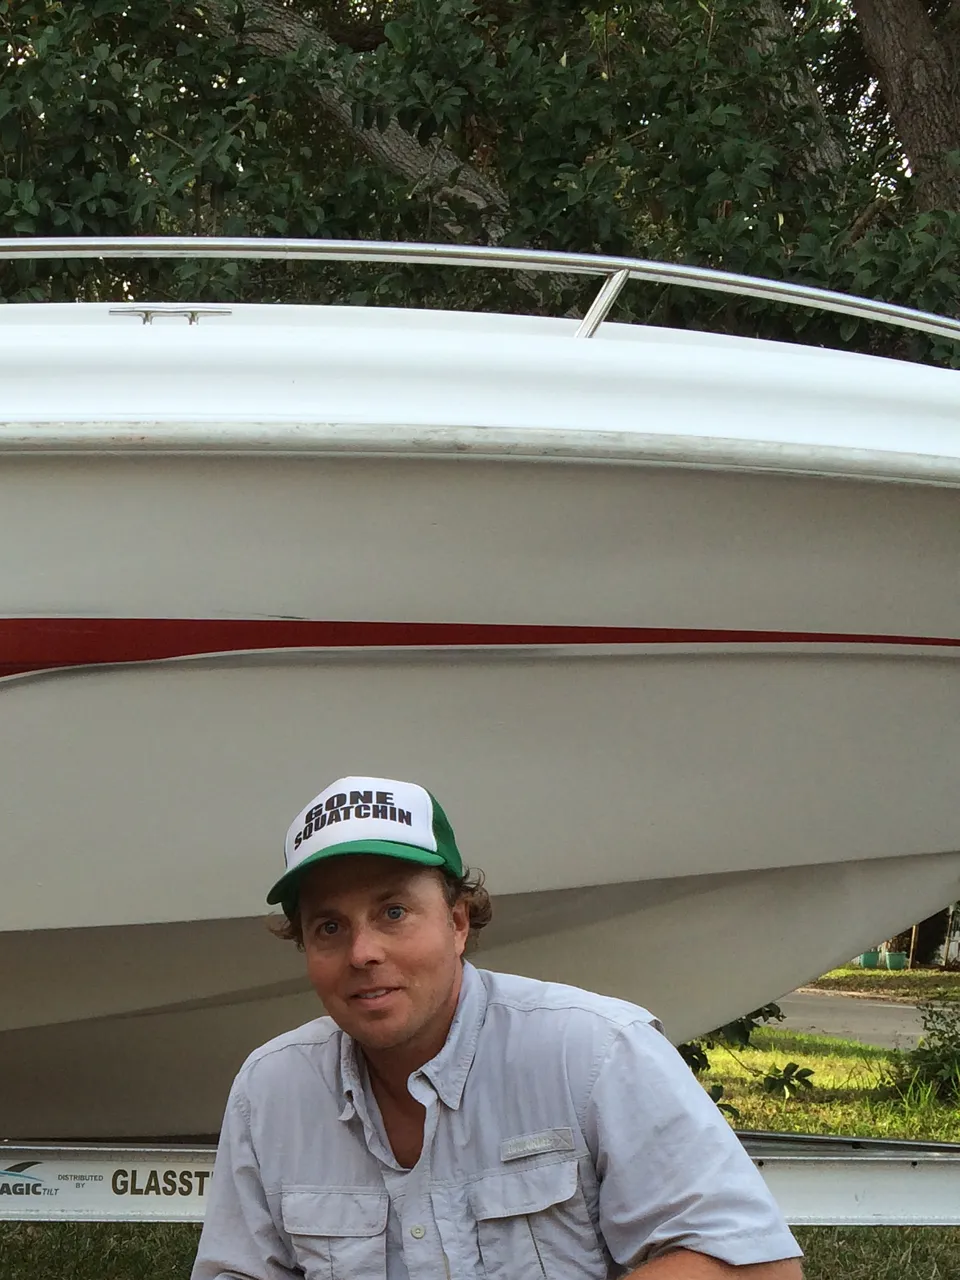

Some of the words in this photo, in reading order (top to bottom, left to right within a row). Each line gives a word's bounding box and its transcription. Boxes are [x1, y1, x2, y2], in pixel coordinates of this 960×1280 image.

[305, 790, 395, 824] GONE
[294, 804, 413, 851] SQUATCHIN
[57, 1174, 104, 1182] DISTRIBUTED
[111, 1168, 213, 1197] GLASST
